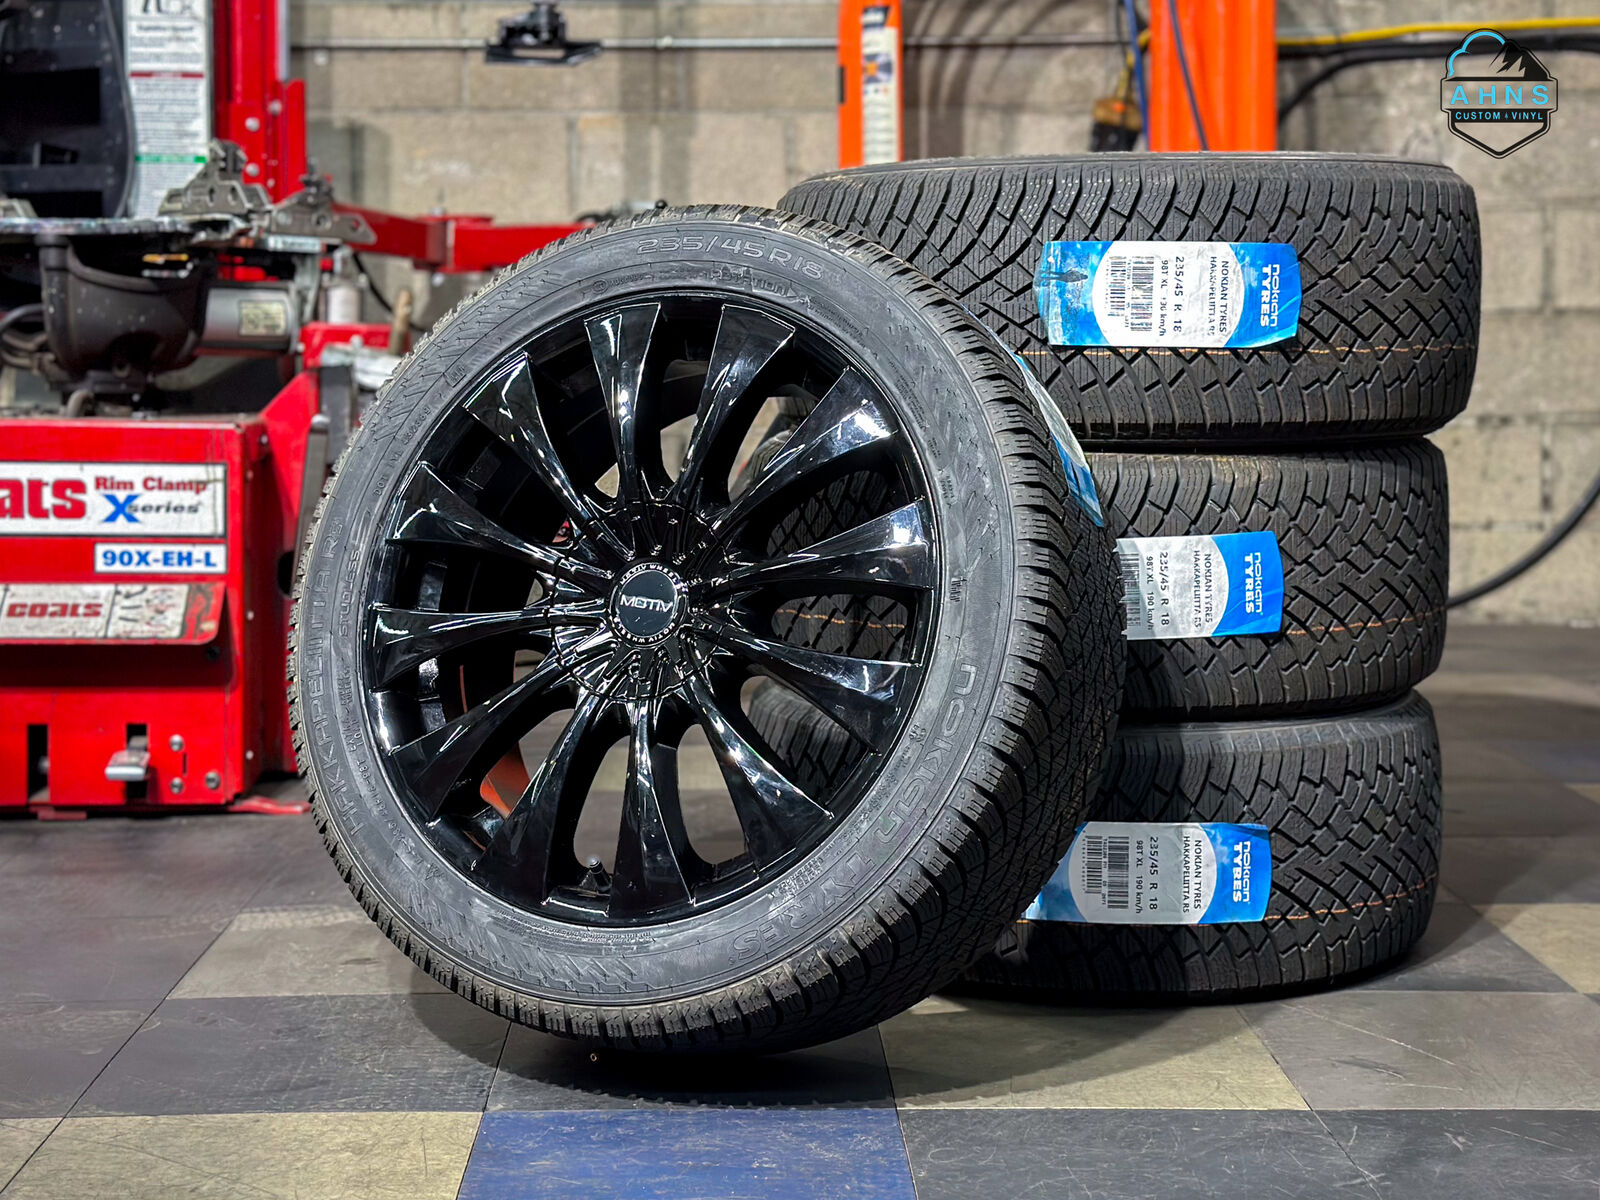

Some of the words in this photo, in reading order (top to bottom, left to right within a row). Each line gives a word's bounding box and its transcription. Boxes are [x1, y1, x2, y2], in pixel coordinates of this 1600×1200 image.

[1161, 259, 1169, 276] 98T
[1173, 256, 1185, 297] 235/45
[1160, 279, 1168, 289] XL
[1220, 260, 1229, 300] NOKIAN
[1260, 264, 1272, 327] TYRES
[1158, 313, 1167, 336] km/h
[1219, 303, 1228, 333] TYRES
[95, 477, 134, 491] Rim
[143, 477, 207, 495] Clamp
[102, 550, 217, 567] 90X-EH-L
[1146, 556, 1154, 573] 98T
[1147, 573, 1154, 584] XL
[1159, 552, 1169, 592] 235/45
[1204, 553, 1212, 593] NOKIAN
[1244, 553, 1254, 614] TYRES
[620, 594, 674, 612] MOTIV
[1160, 598, 1169, 606] R
[1204, 594, 1213, 623] TYRES
[1146, 607, 1155, 631] km/h
[1161, 612, 1170, 626] 18
[1136, 840, 1144, 855] 98T
[1149, 836, 1159, 875] 235/45
[1136, 857, 1143, 868] XL
[1194, 840, 1202, 878] NOKIAN
[1233, 842, 1243, 903] TYRES
[1149, 882, 1158, 890] R
[1194, 881, 1202, 910] TYRES
[730, 846, 877, 960] TYRES
[1135, 892, 1143, 914] km/h
[1149, 897, 1158, 910] 18
[1182, 903, 1190, 913] R5
